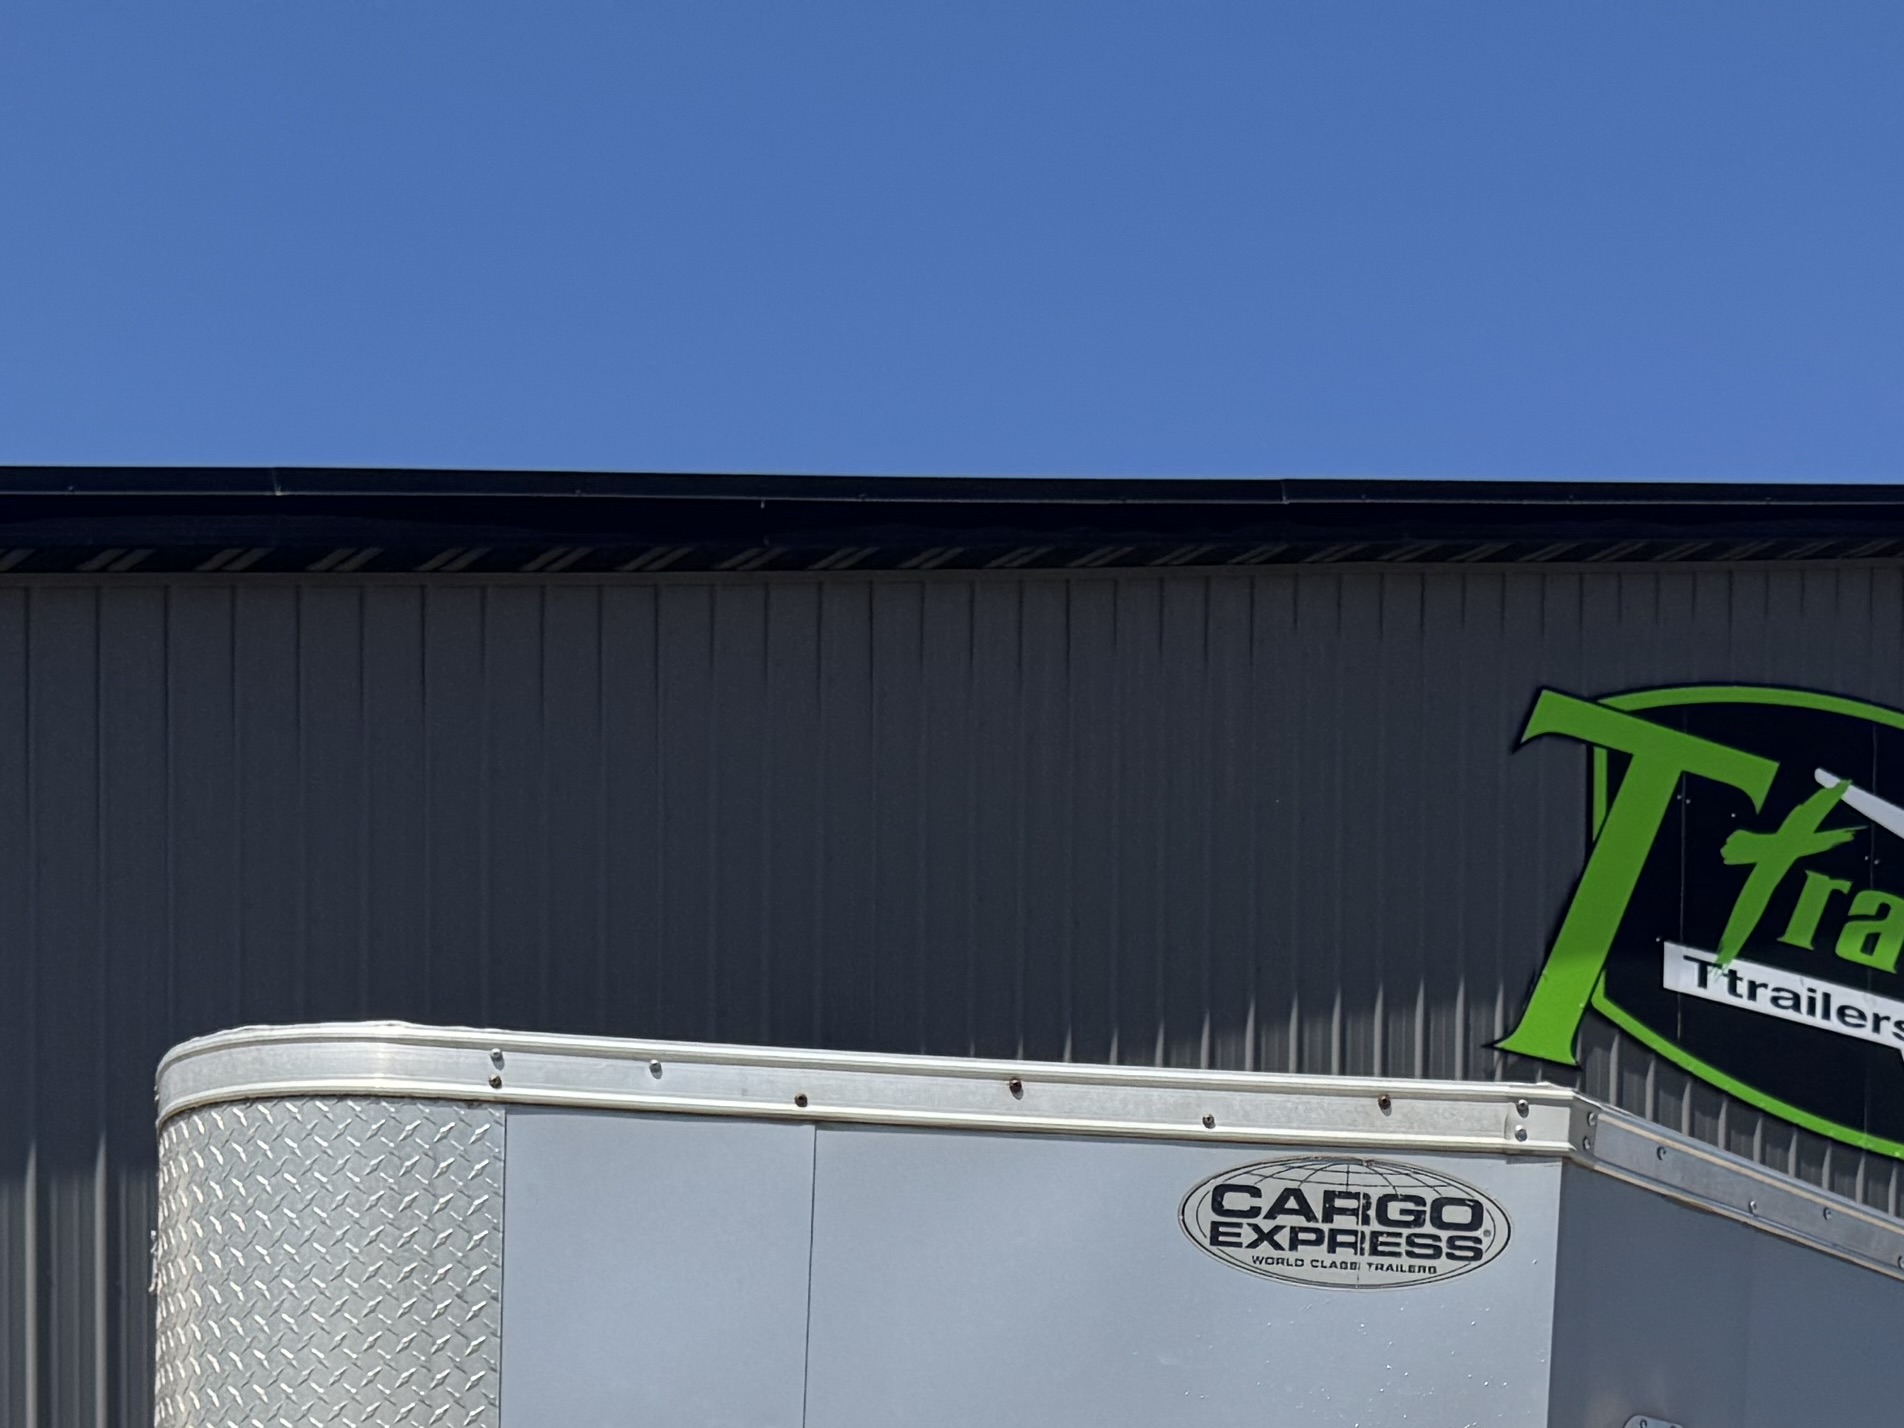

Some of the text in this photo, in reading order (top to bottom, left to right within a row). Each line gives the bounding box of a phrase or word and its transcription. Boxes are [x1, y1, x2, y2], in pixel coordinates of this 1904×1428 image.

[1210, 1183, 1485, 1233] CARGO
[1209, 1221, 1484, 1262] EXPRESS
[1251, 1255, 1438, 1275] WORLD CLASS TRAILERS
